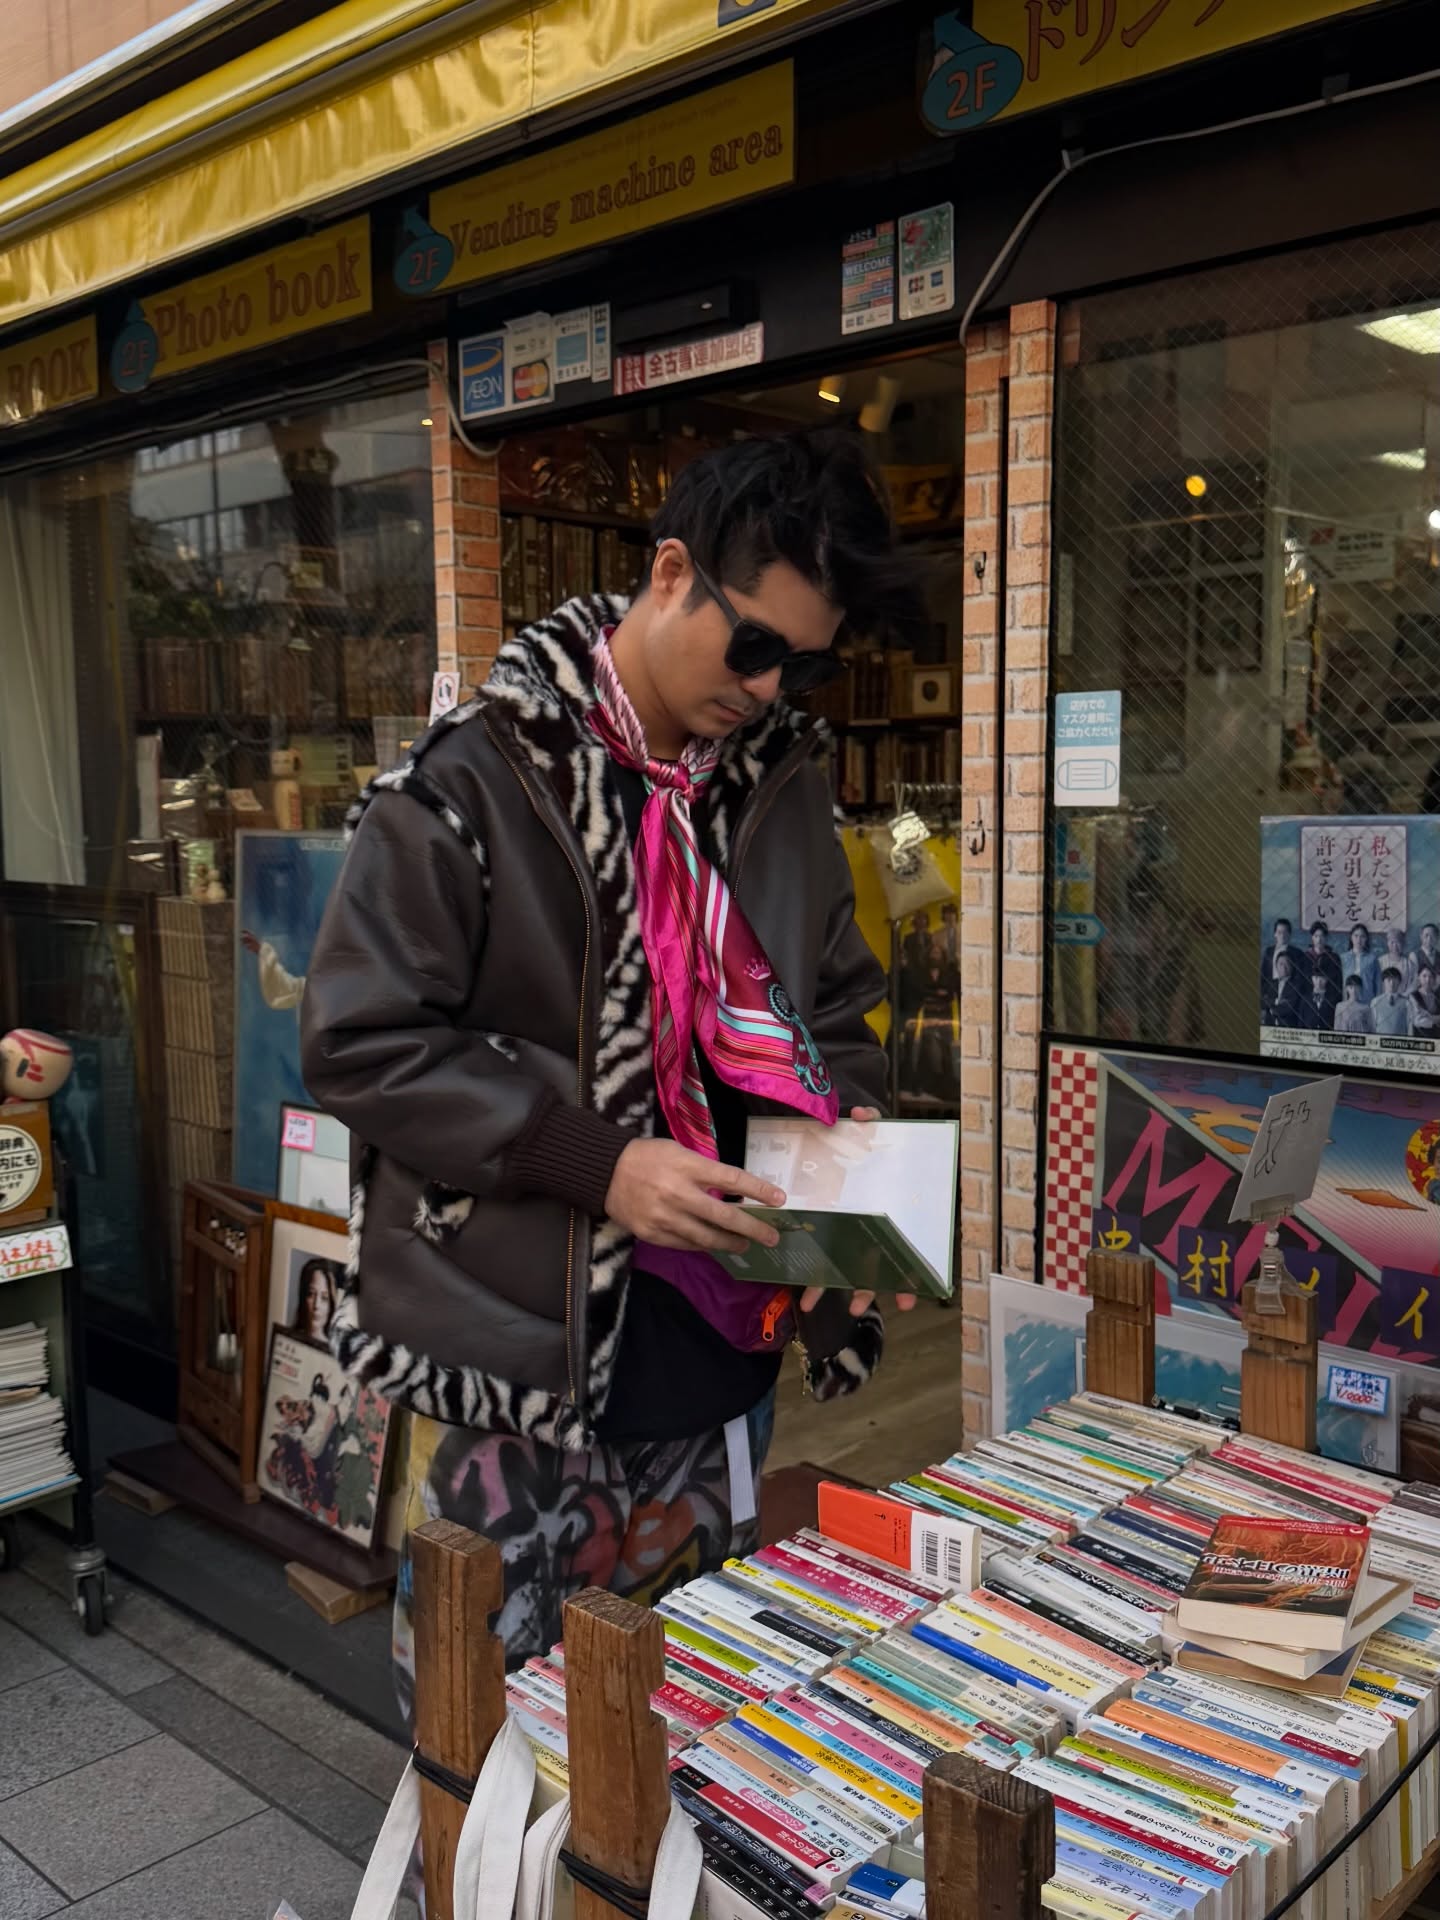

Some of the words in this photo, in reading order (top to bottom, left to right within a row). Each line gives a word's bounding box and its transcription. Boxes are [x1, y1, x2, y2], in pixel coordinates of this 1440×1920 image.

[1023, 0, 1222, 82] ドリン
[946, 61, 997, 119] 2F
[450, 200, 560, 261] Vending
[569, 155, 697, 225] machine
[708, 124, 783, 177] area
[154, 286, 252, 364] Photo
[264, 236, 362, 326] book
[408, 247, 441, 287] 2F
[845, 256, 892, 275] WELCOME
[7, 336, 92, 406] BOOK
[121, 340, 149, 377] 2F
[1316, 835, 1337, 920] 許さない
[1343, 835, 1364, 922] 万引きを
[1370, 835, 1392, 922] 私たちは
